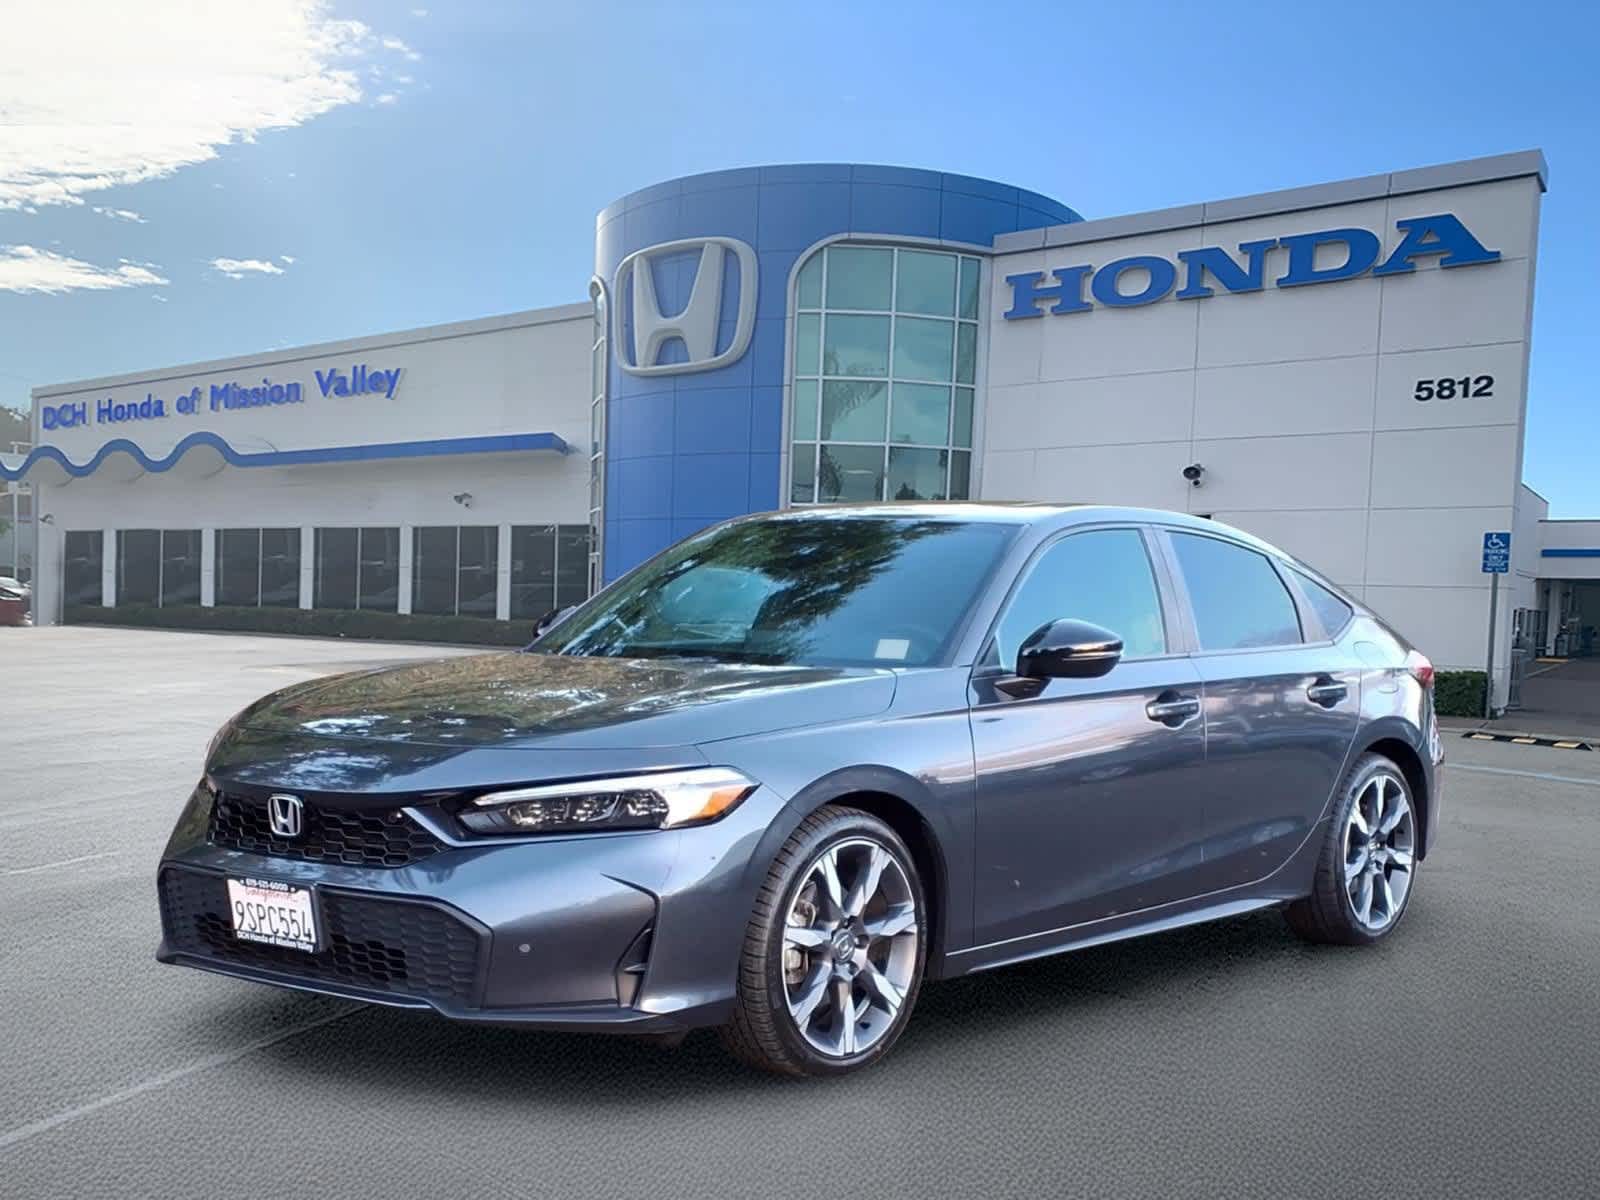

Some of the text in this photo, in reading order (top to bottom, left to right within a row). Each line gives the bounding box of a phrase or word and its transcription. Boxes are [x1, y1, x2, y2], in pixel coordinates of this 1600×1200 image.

[1003, 213, 1502, 321] HONDA
[42, 365, 403, 431] DCH Honda of Mission Valley
[1414, 375, 1494, 401] 5812
[235, 900, 312, 941] 9SPC554
